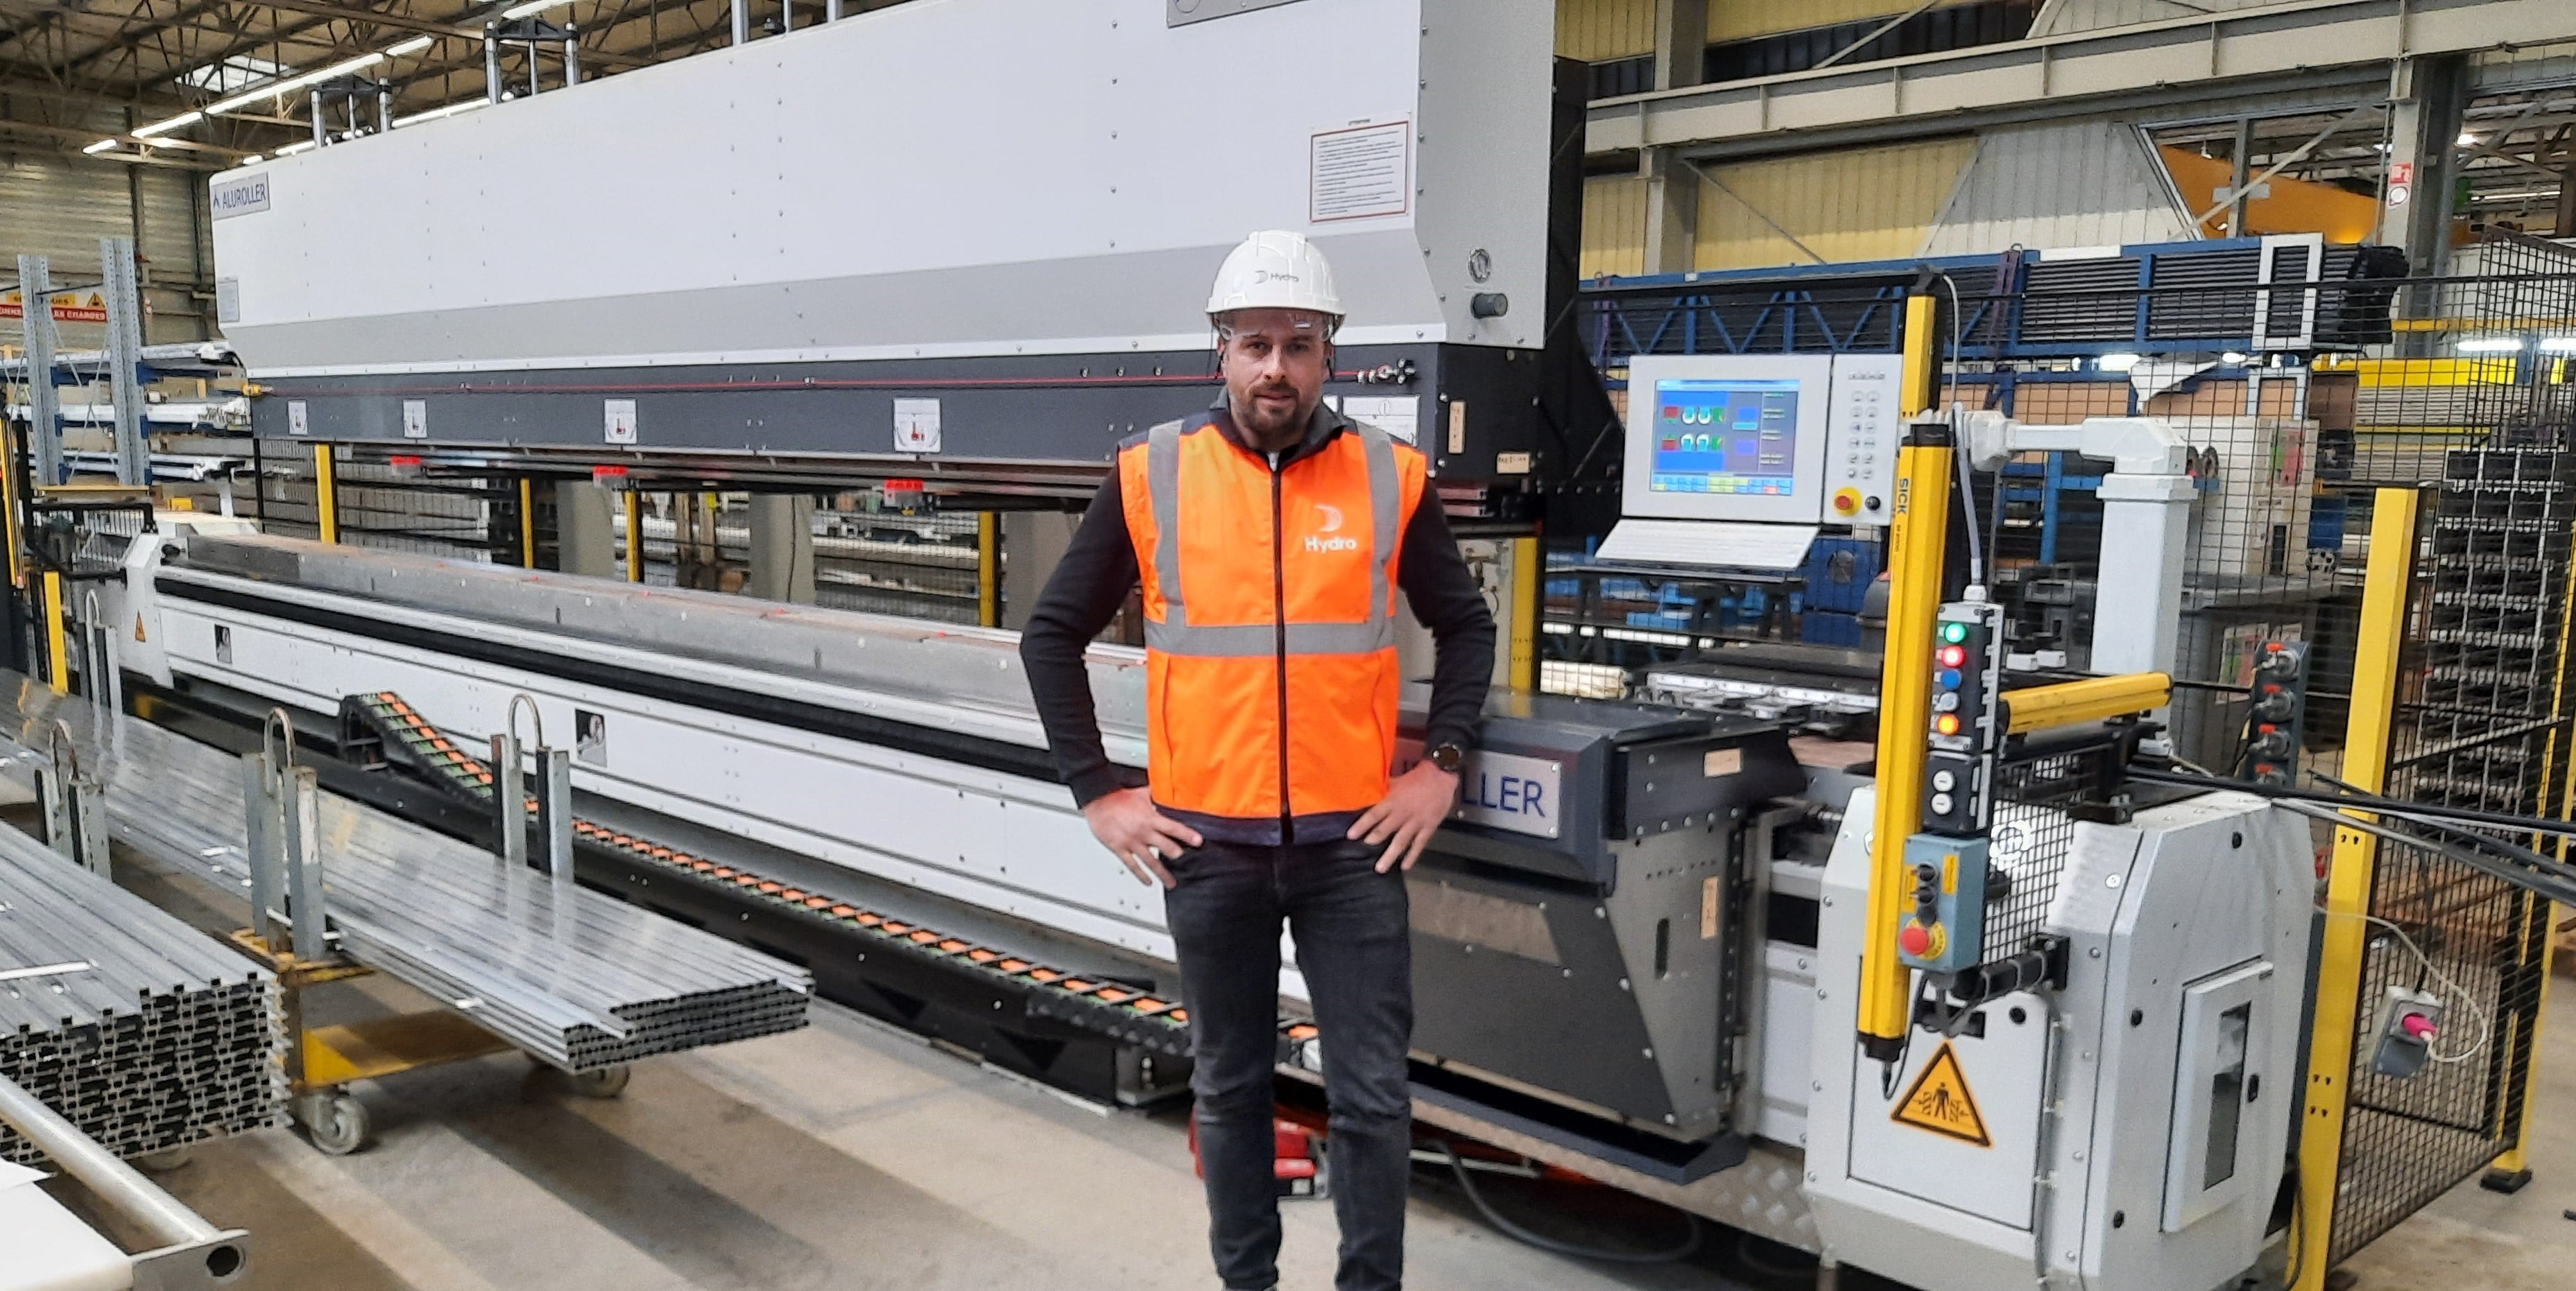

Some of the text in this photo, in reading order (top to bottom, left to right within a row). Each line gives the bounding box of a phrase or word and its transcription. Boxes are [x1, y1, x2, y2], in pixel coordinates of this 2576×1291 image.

[223, 183, 266, 209] ALUROLLER
[1270, 272, 1299, 283] Hydro
[1897, 478, 1909, 515] SICK
[1304, 535, 1358, 555] Hydro
